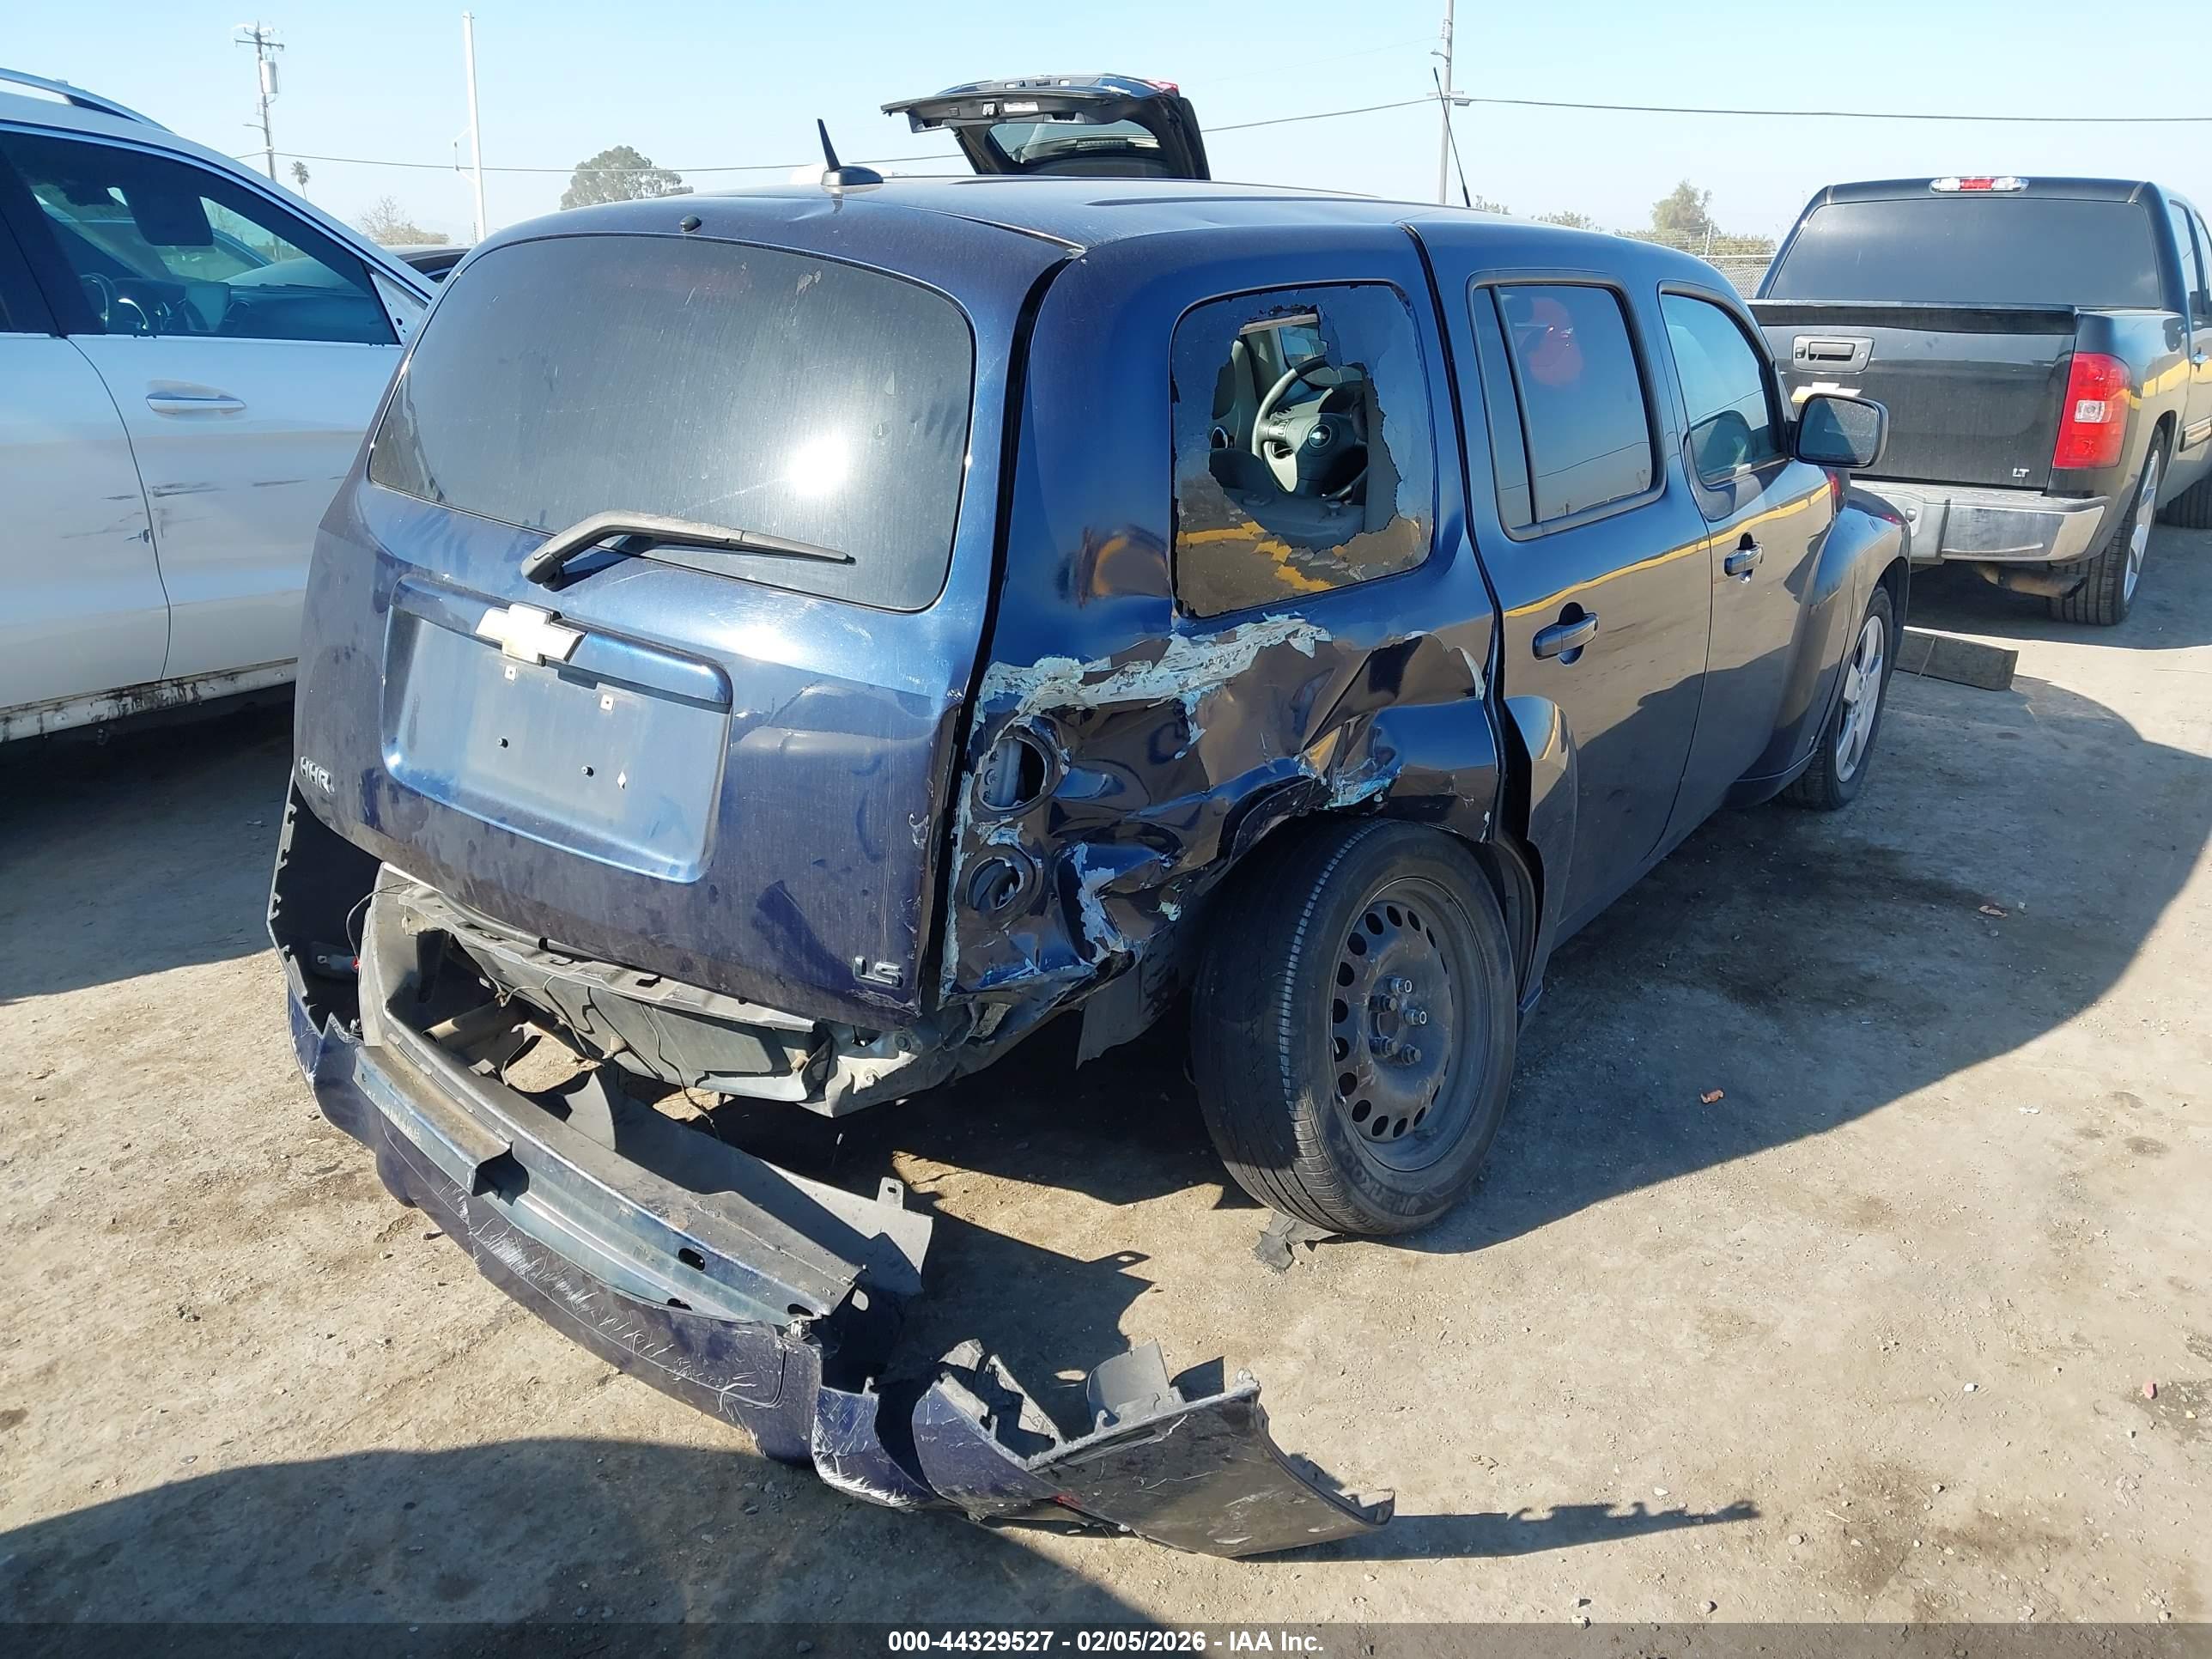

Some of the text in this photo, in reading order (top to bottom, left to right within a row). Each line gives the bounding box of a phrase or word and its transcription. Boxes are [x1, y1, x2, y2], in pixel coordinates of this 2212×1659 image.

[2012, 467, 2030, 477] LT
[300, 755, 335, 796] HHR
[853, 954, 902, 988] LS
